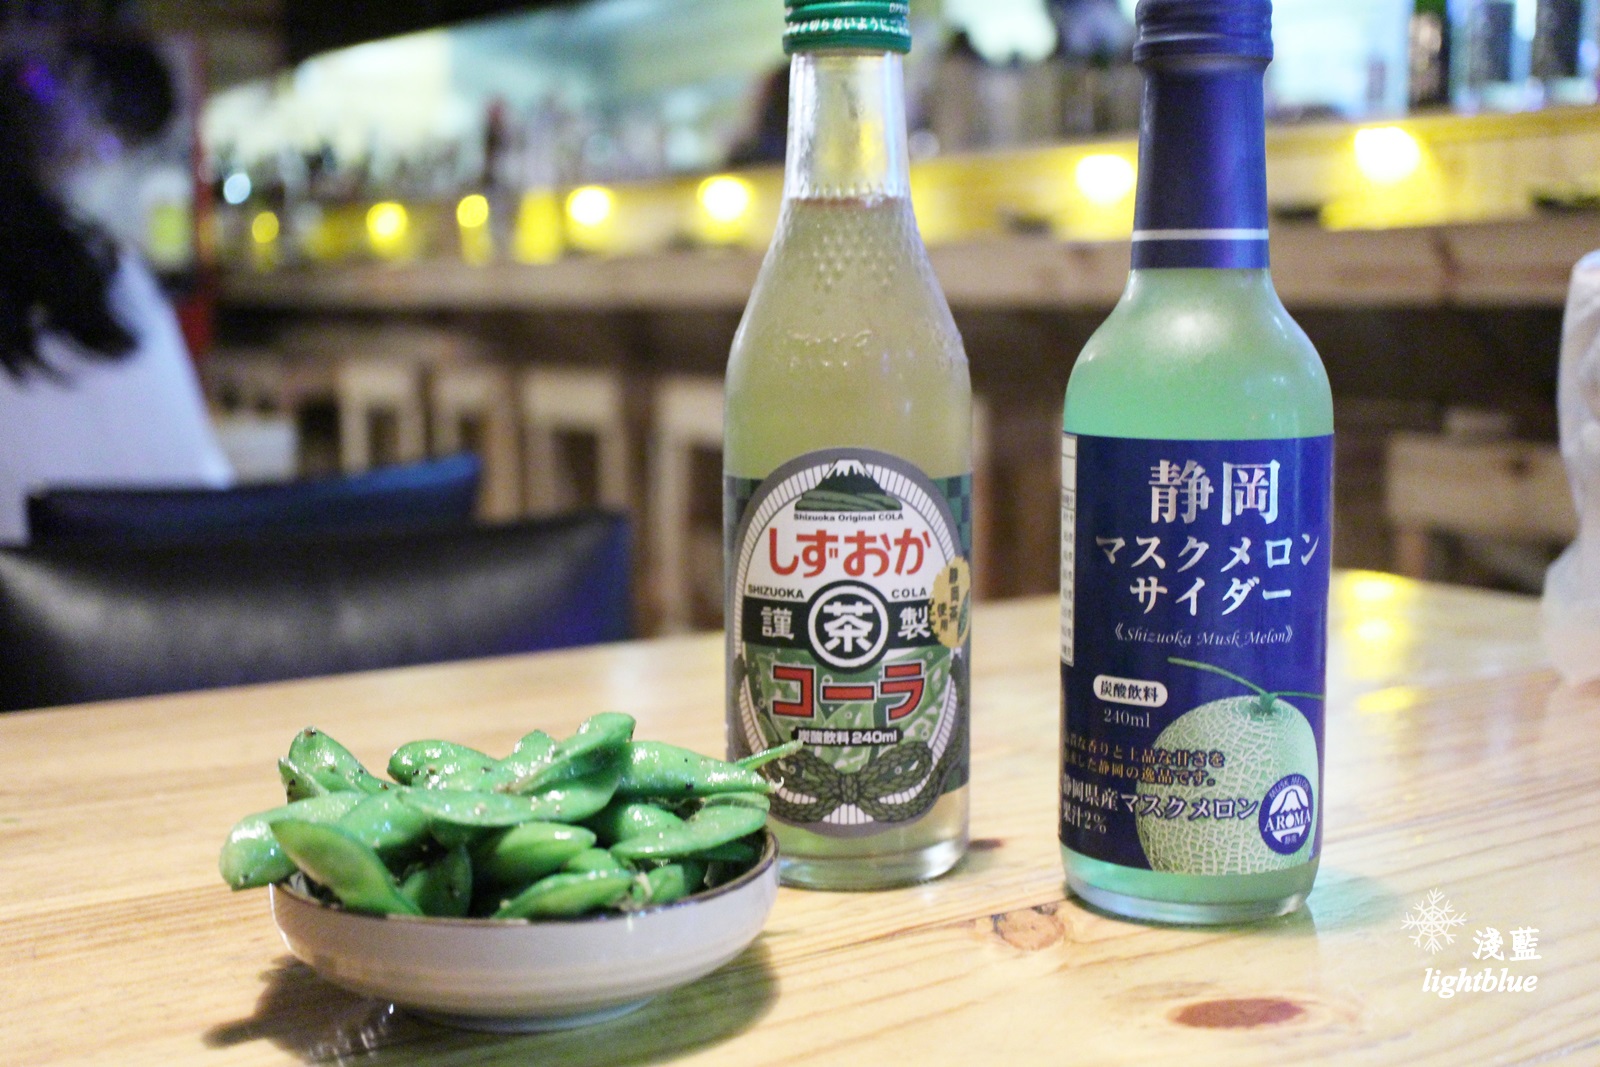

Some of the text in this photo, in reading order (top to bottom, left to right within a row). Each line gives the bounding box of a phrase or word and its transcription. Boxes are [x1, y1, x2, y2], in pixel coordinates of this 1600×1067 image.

[1148, 459, 1281, 525] 静岡
[793, 513, 904, 523] Shizuoka Original COLA
[769, 527, 931, 578] しずおか
[1095, 533, 1320, 573] マスクメロン
[748, 584, 928, 599] SHIZUOKA COLA
[1129, 576, 1292, 616] サイダー
[822, 601, 874, 653] 茶
[771, 661, 926, 722] コーラ
[1100, 680, 1159, 703] 炭酸飲料
[1103, 708, 1151, 728] 240ml
[851, 730, 898, 744] 240ml
[1264, 808, 1312, 833] AROMA
